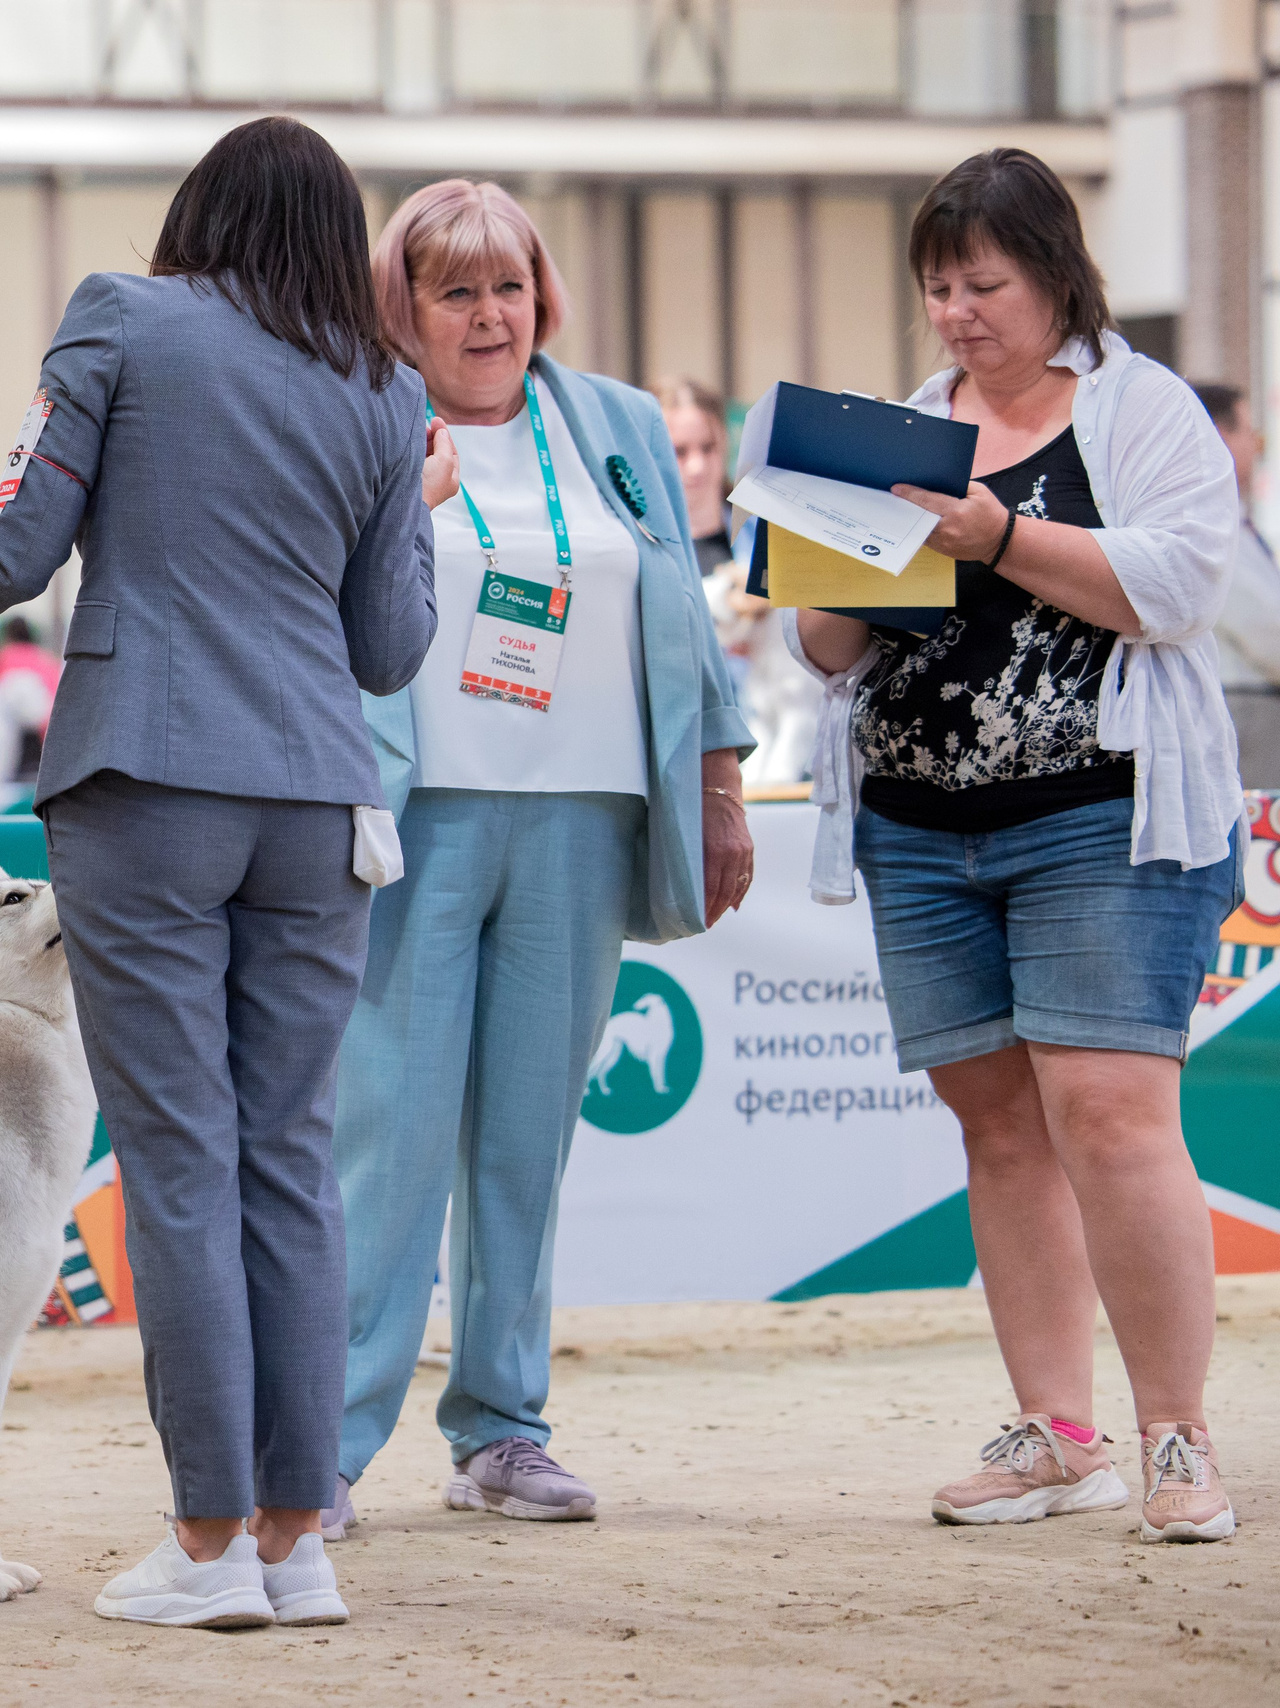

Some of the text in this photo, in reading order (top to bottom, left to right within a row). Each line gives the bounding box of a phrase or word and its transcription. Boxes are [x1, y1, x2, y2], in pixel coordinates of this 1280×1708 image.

[532, 414, 542, 431] РКФ
[539, 450, 550, 467] РКФ
[546, 485, 557, 502] РКФ
[554, 519, 565, 536] РКФ
[508, 586, 525, 596] 2024
[506, 593, 544, 610] РОССИЯ
[499, 635, 536, 652] СУДЬЯ
[500, 650, 531, 664] Наталья
[491, 657, 536, 675] ТИХОНОВА
[504, 682, 511, 690] 2
[535, 690, 541, 698] 3
[734, 1031, 897, 1059] кинолог
